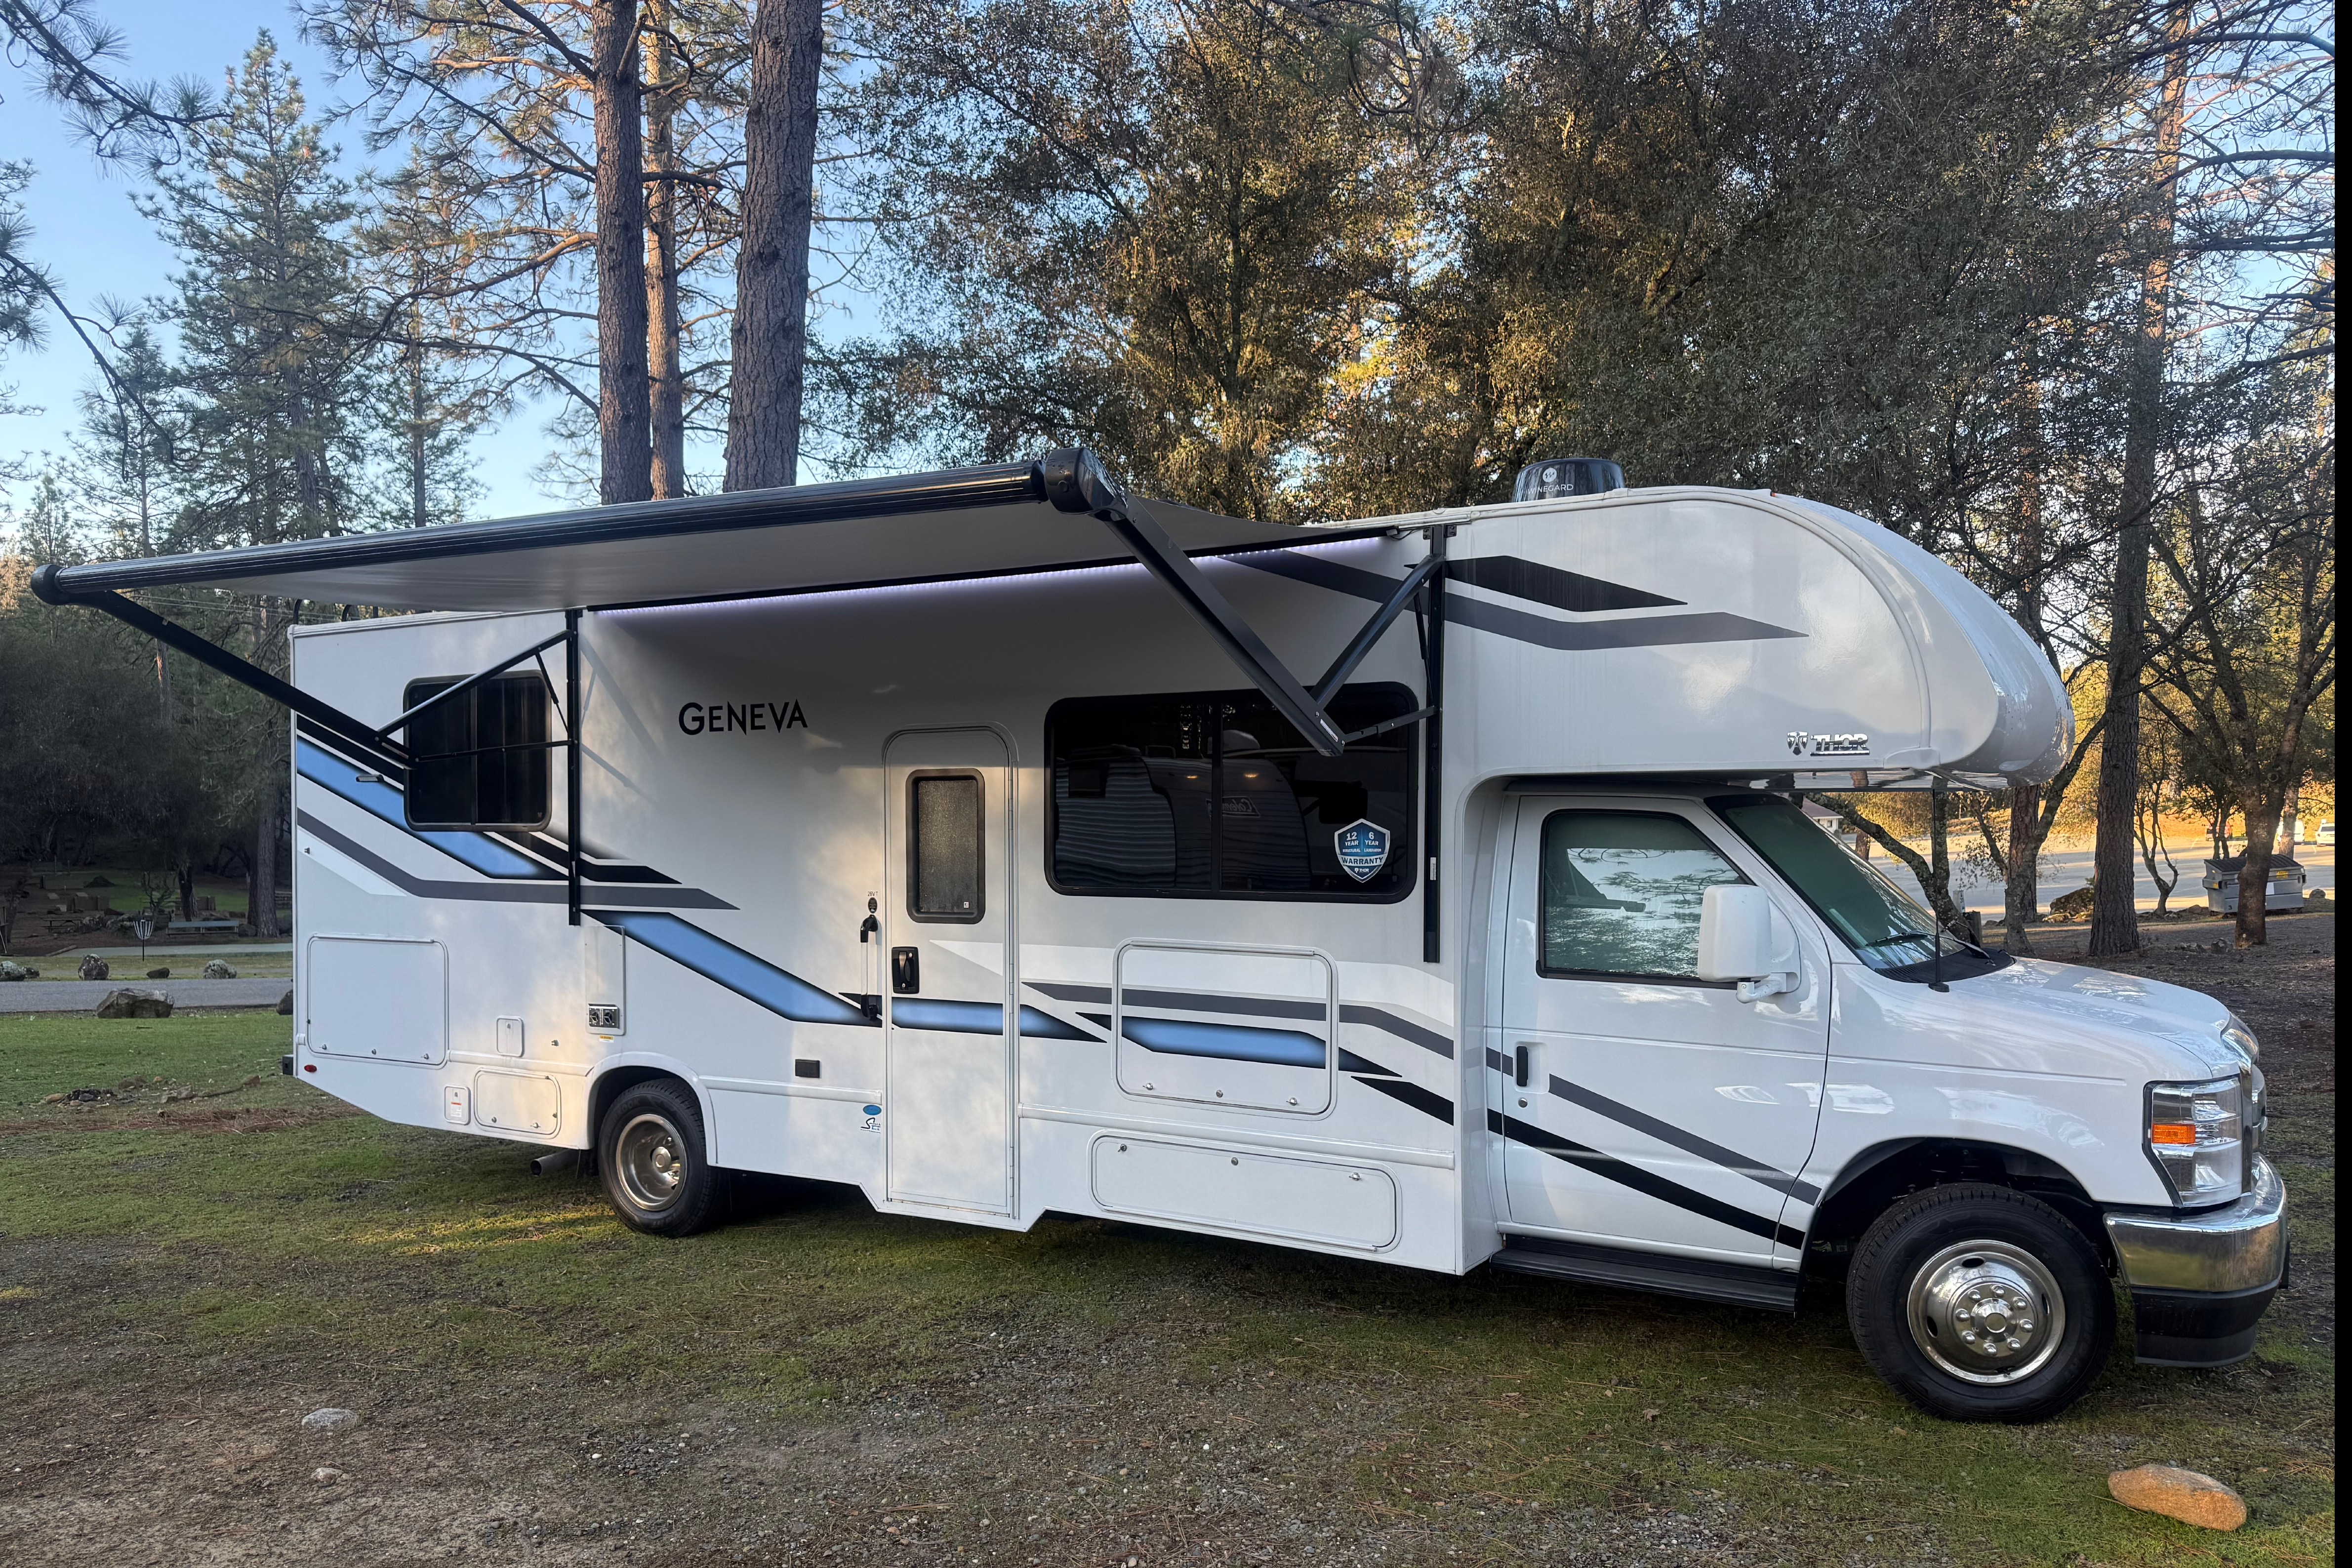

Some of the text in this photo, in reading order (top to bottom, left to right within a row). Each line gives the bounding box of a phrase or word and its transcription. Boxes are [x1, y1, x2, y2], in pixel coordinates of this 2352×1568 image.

[1528, 484, 1574, 494] WINEGARD
[679, 699, 808, 735] GENEVA
[1811, 733, 1870, 751] THOR
[1346, 832, 1357, 841] 12
[1341, 856, 1383, 865] WARRANTY
